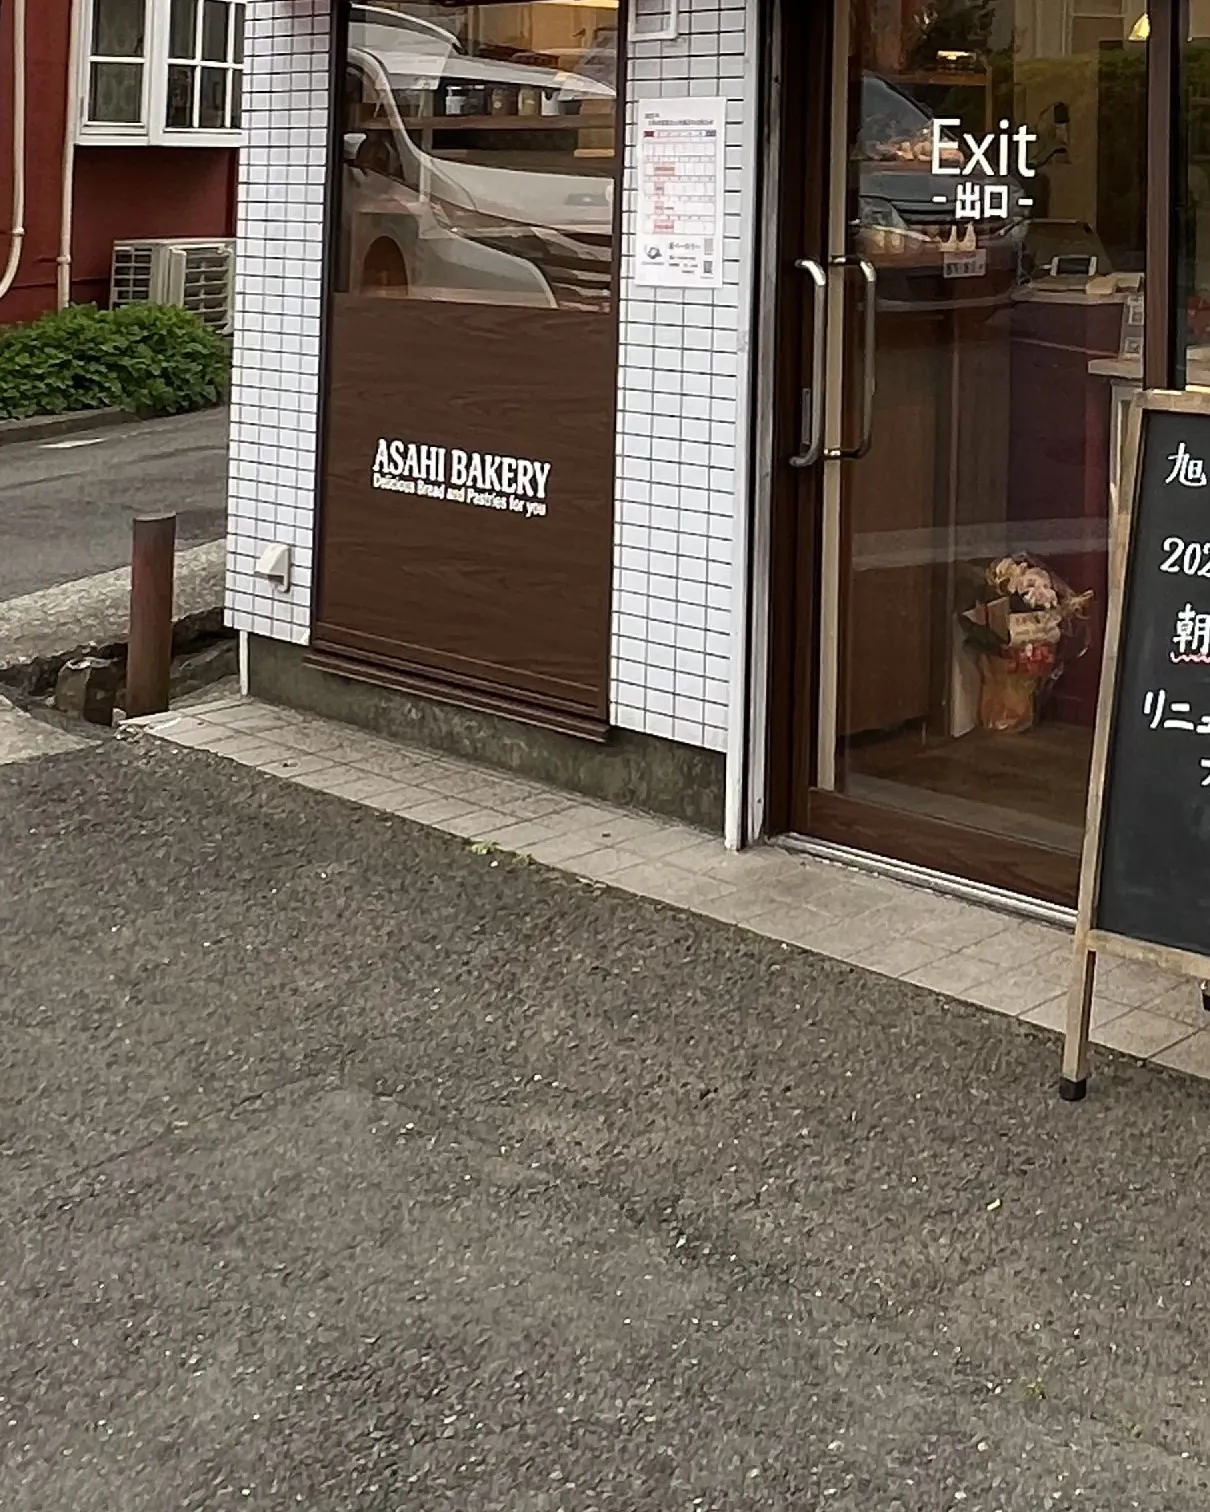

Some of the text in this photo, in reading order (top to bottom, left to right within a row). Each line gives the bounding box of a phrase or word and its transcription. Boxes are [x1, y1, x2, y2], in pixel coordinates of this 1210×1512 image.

[931, 118, 1037, 177] Exit
[372, 438, 551, 499] ASAHI BAKERY
